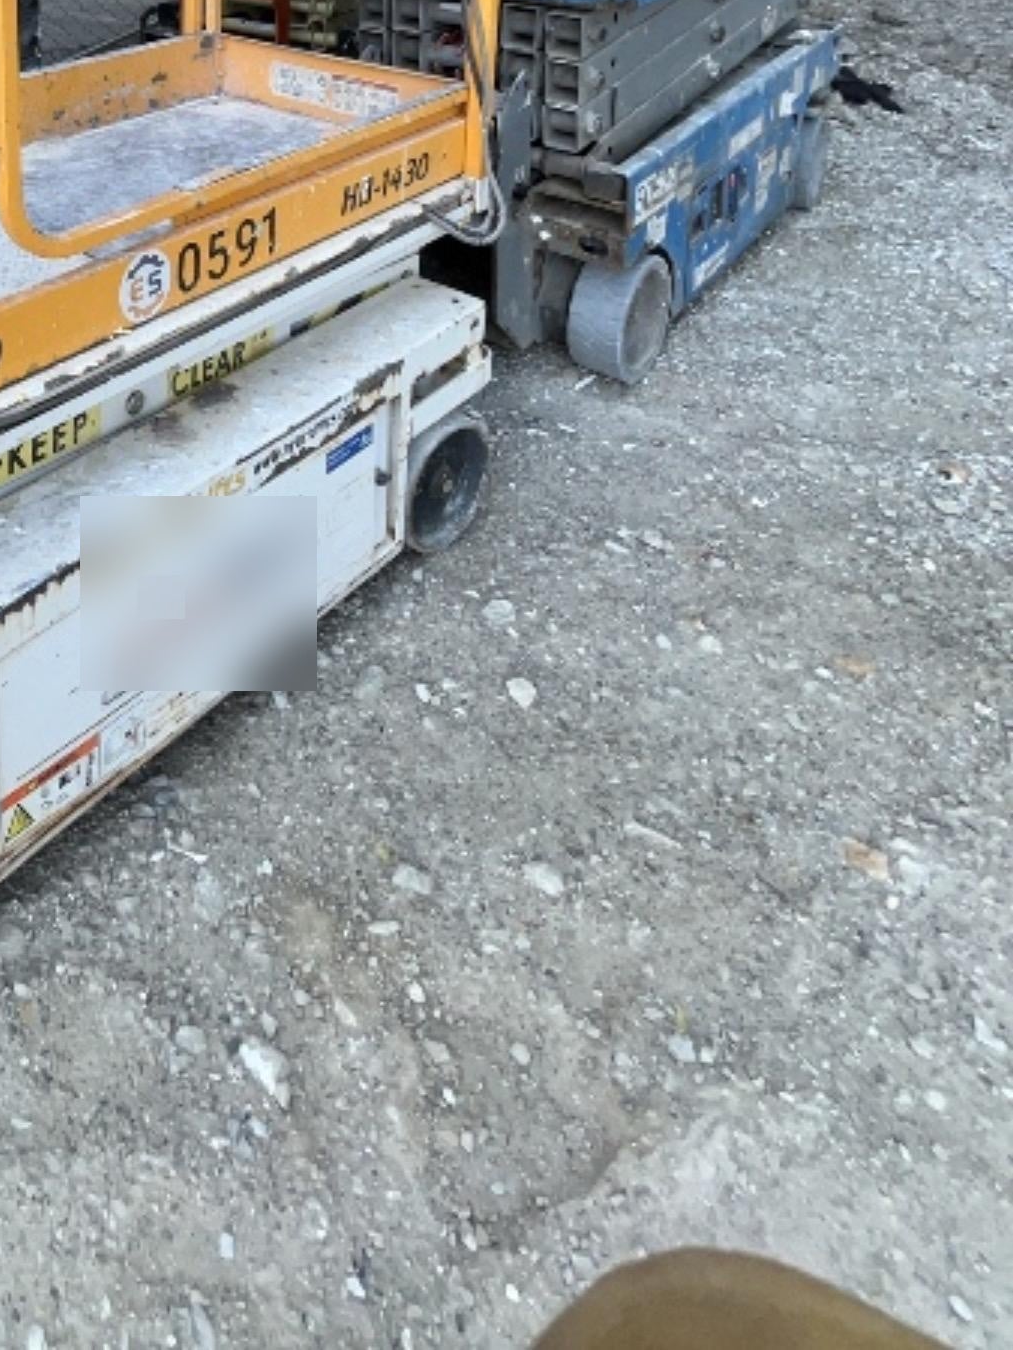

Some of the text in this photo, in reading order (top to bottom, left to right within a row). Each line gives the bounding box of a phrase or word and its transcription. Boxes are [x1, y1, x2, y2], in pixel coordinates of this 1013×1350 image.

[177, 205, 277, 293] 0591
[6, 340, 247, 476] KEEP CLEAR
